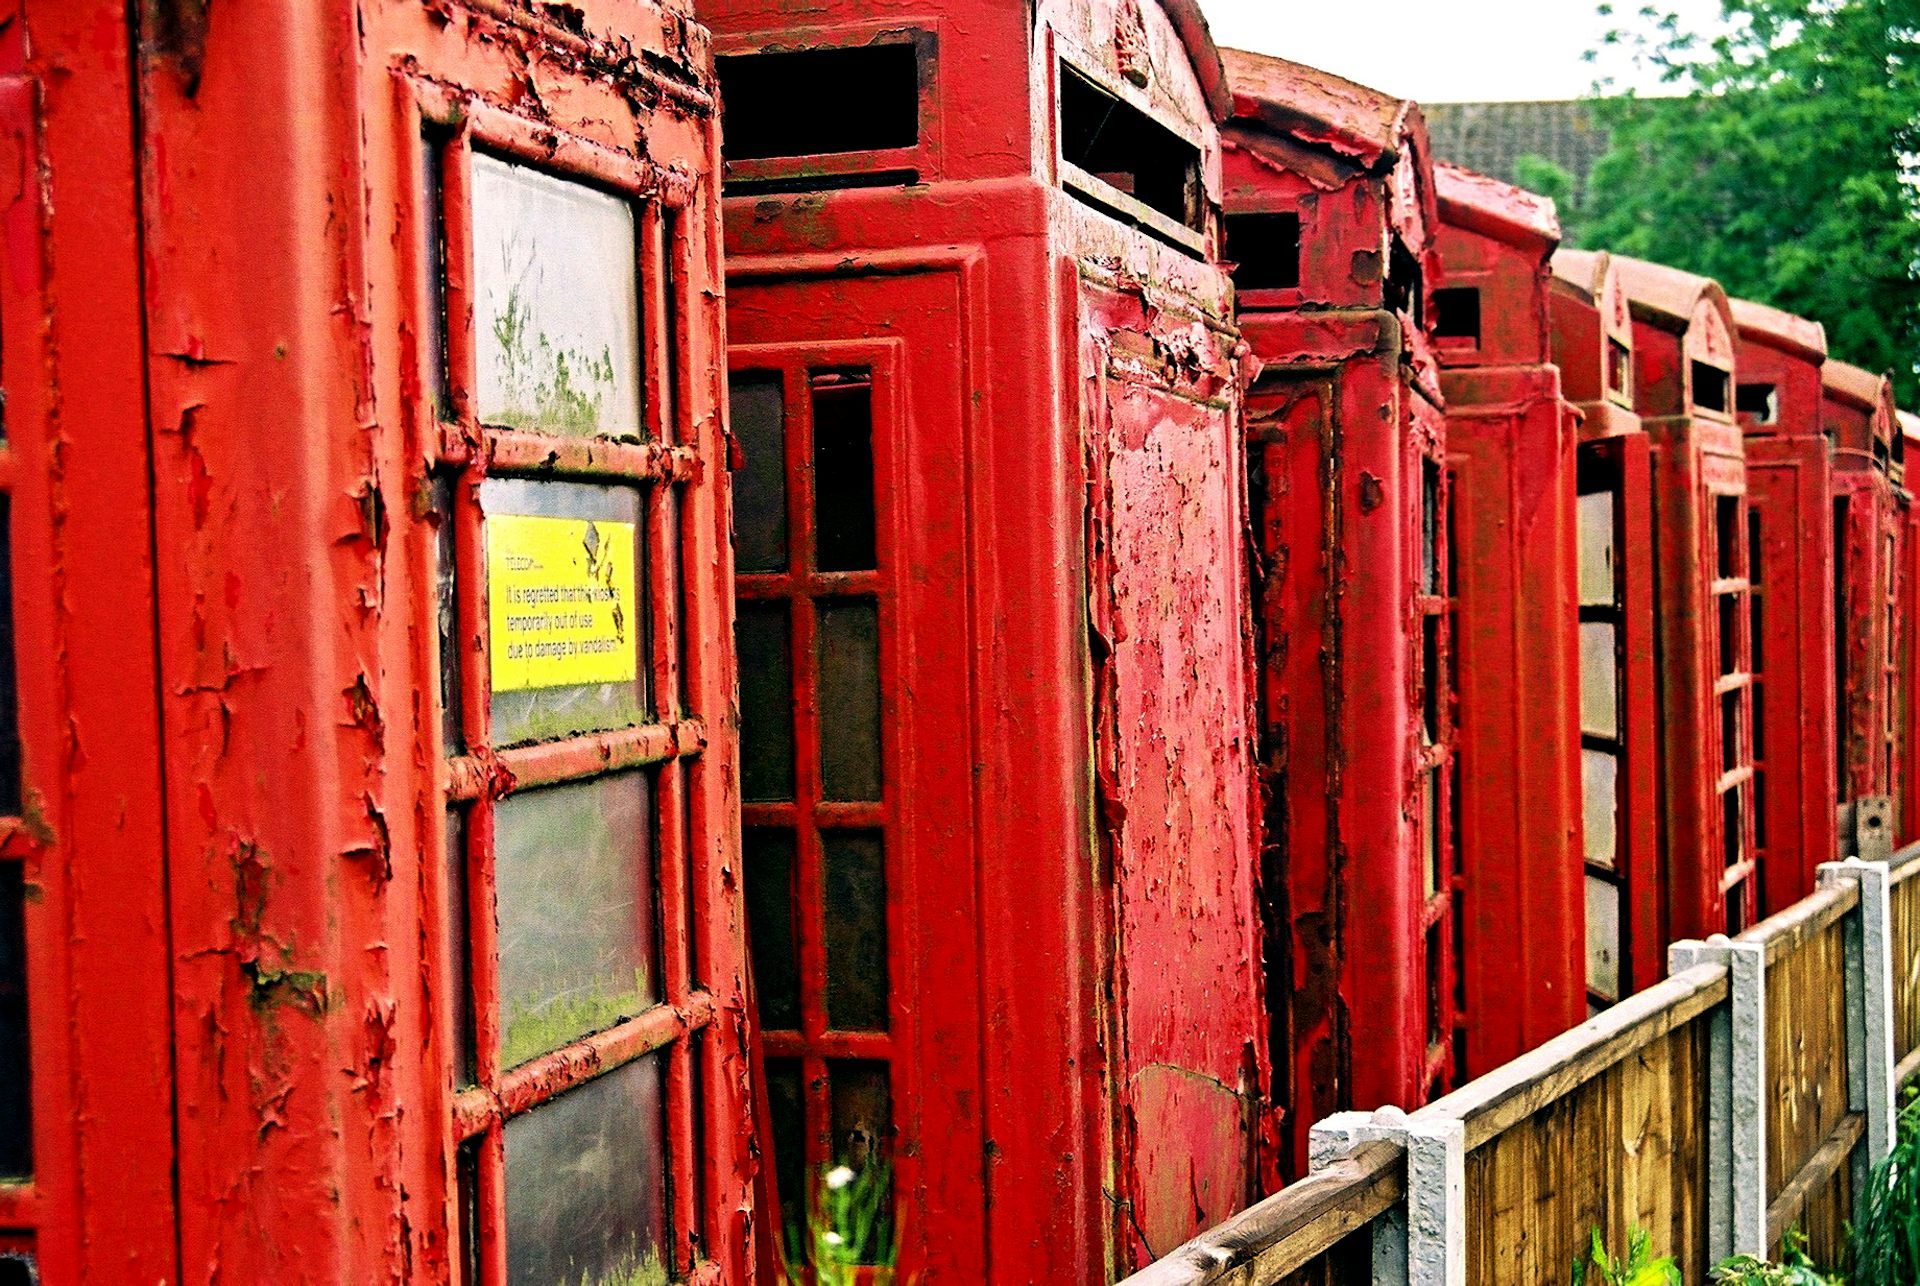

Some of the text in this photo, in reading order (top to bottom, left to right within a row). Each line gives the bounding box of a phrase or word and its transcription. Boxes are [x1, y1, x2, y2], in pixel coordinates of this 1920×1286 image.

[514, 585, 521, 603] is
[523, 585, 559, 609] regretted
[561, 585, 577, 603] that
[507, 610, 593, 635] temporarily out of use
[507, 640, 524, 660] due
[525, 640, 533, 659] to
[535, 637, 567, 661] damage
[568, 636, 578, 659] by
